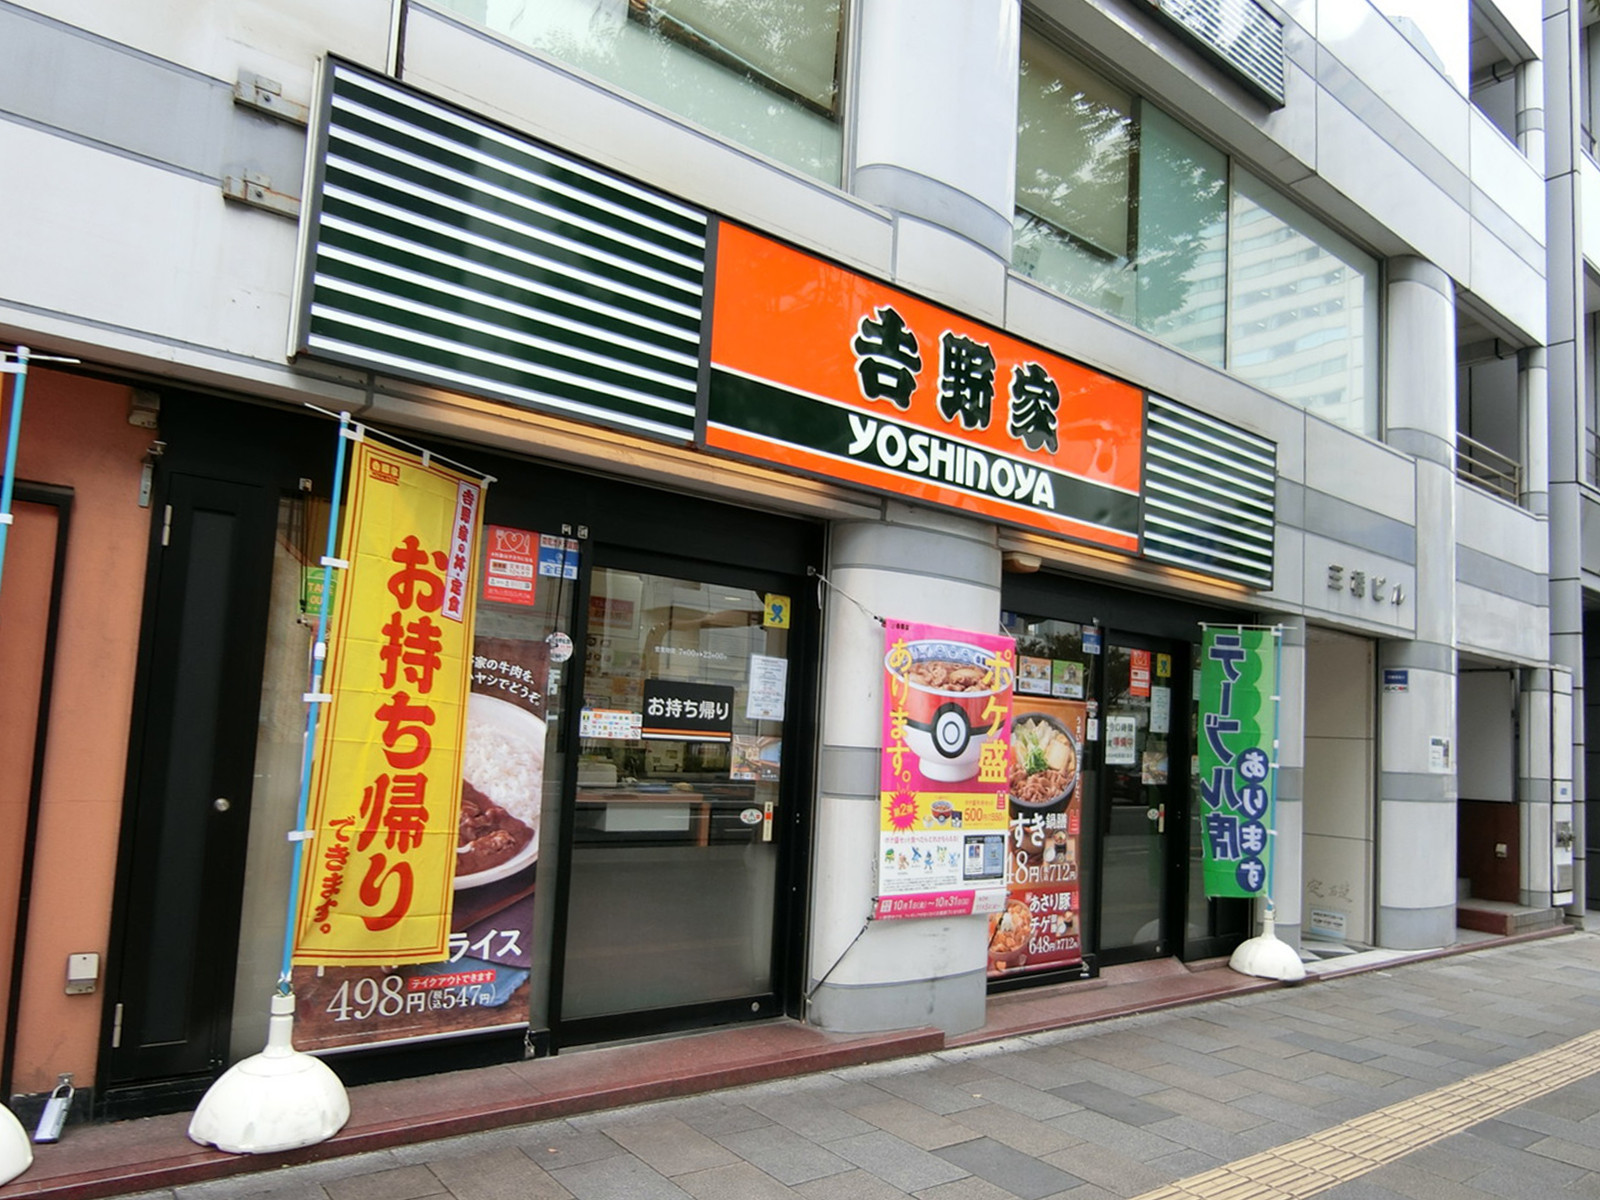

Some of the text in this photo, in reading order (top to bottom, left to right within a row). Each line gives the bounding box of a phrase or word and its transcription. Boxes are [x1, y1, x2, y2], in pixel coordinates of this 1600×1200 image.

[850, 305, 1061, 455] 吉野家
[848, 413, 1055, 509] YOSHINOYA
[308, 582, 335, 593] TAE
[471, 655, 536, 685] 家の牛肉を、
[647, 696, 730, 721] お持ち帰り
[886, 638, 913, 783] あります。
[978, 649, 1012, 783] ポケ盛
[357, 534, 448, 932] お持ち帰り
[314, 815, 355, 934] できます。
[411, 971, 494, 988] テイクアウトできます
